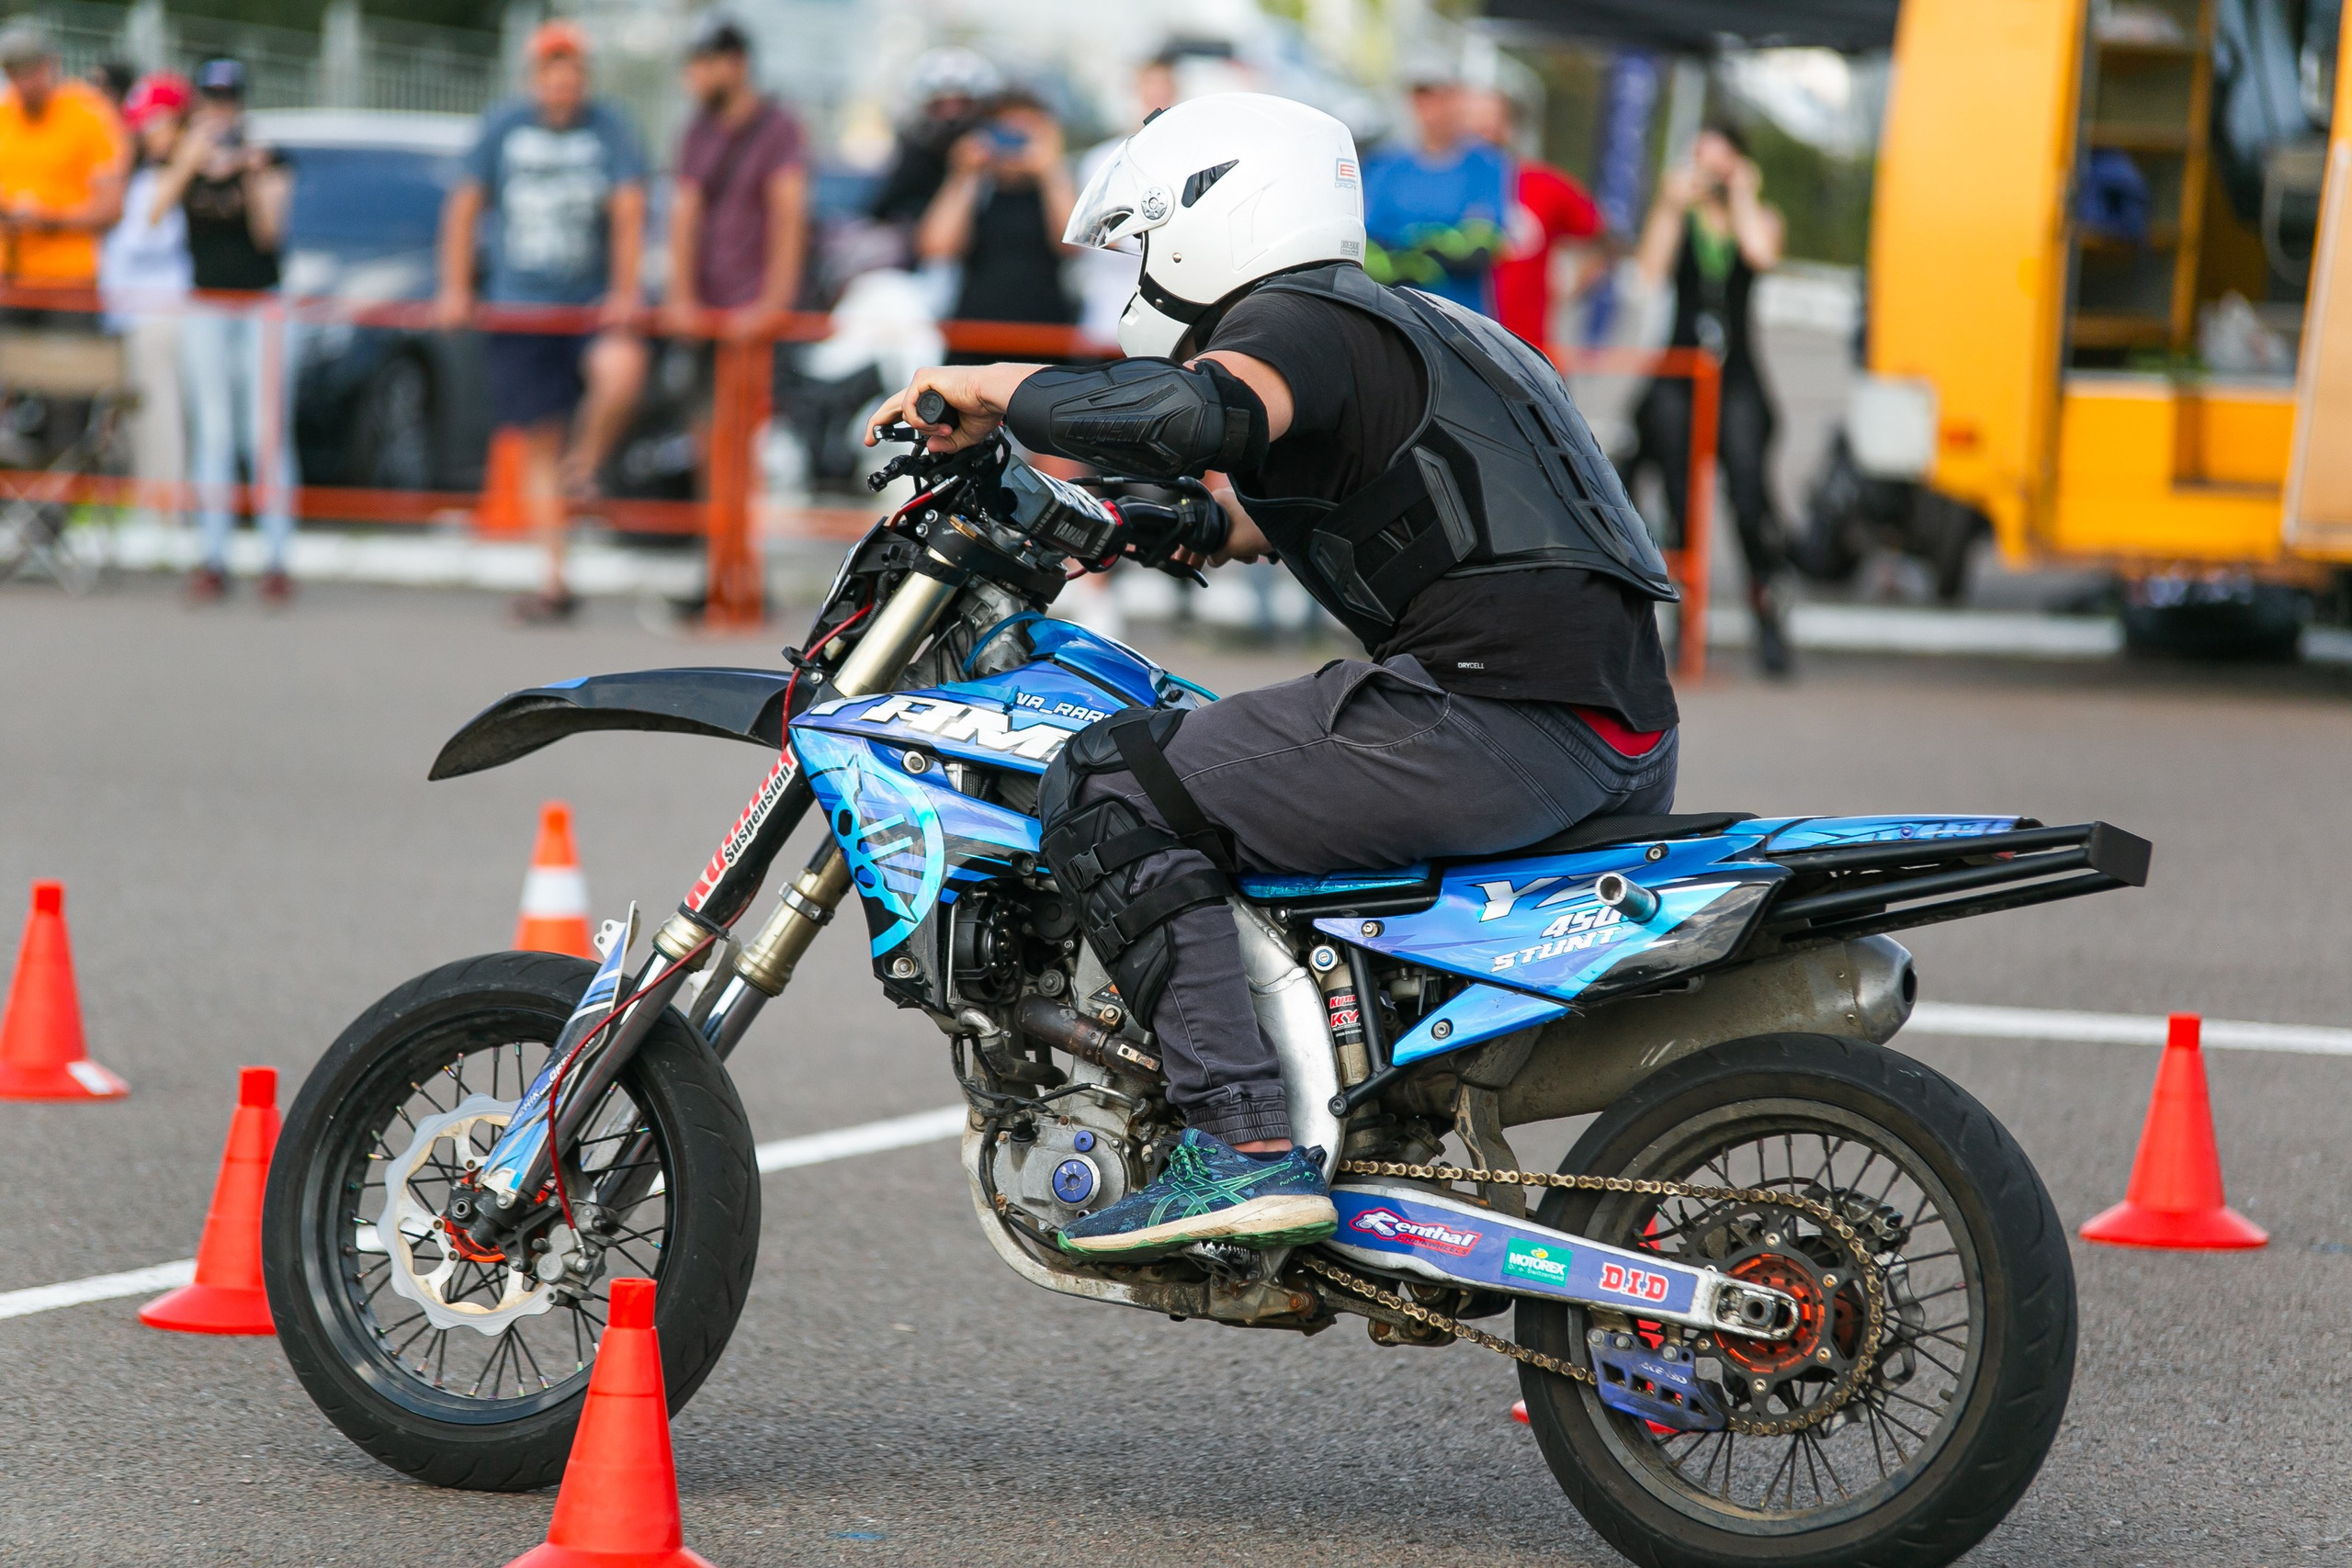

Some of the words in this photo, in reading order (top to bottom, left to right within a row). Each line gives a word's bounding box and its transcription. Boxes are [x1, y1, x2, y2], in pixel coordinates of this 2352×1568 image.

[1053, 520, 1091, 549] YAMAHA
[724, 765, 791, 863] Suspension
[1490, 926, 1623, 973] STUNT
[1355, 1212, 1476, 1247] Renthal
[1398, 1235, 1467, 1256] CHAINWHEELS
[1510, 1253, 1567, 1275] MOTOREX
[1600, 1263, 1668, 1302] D.I.D
